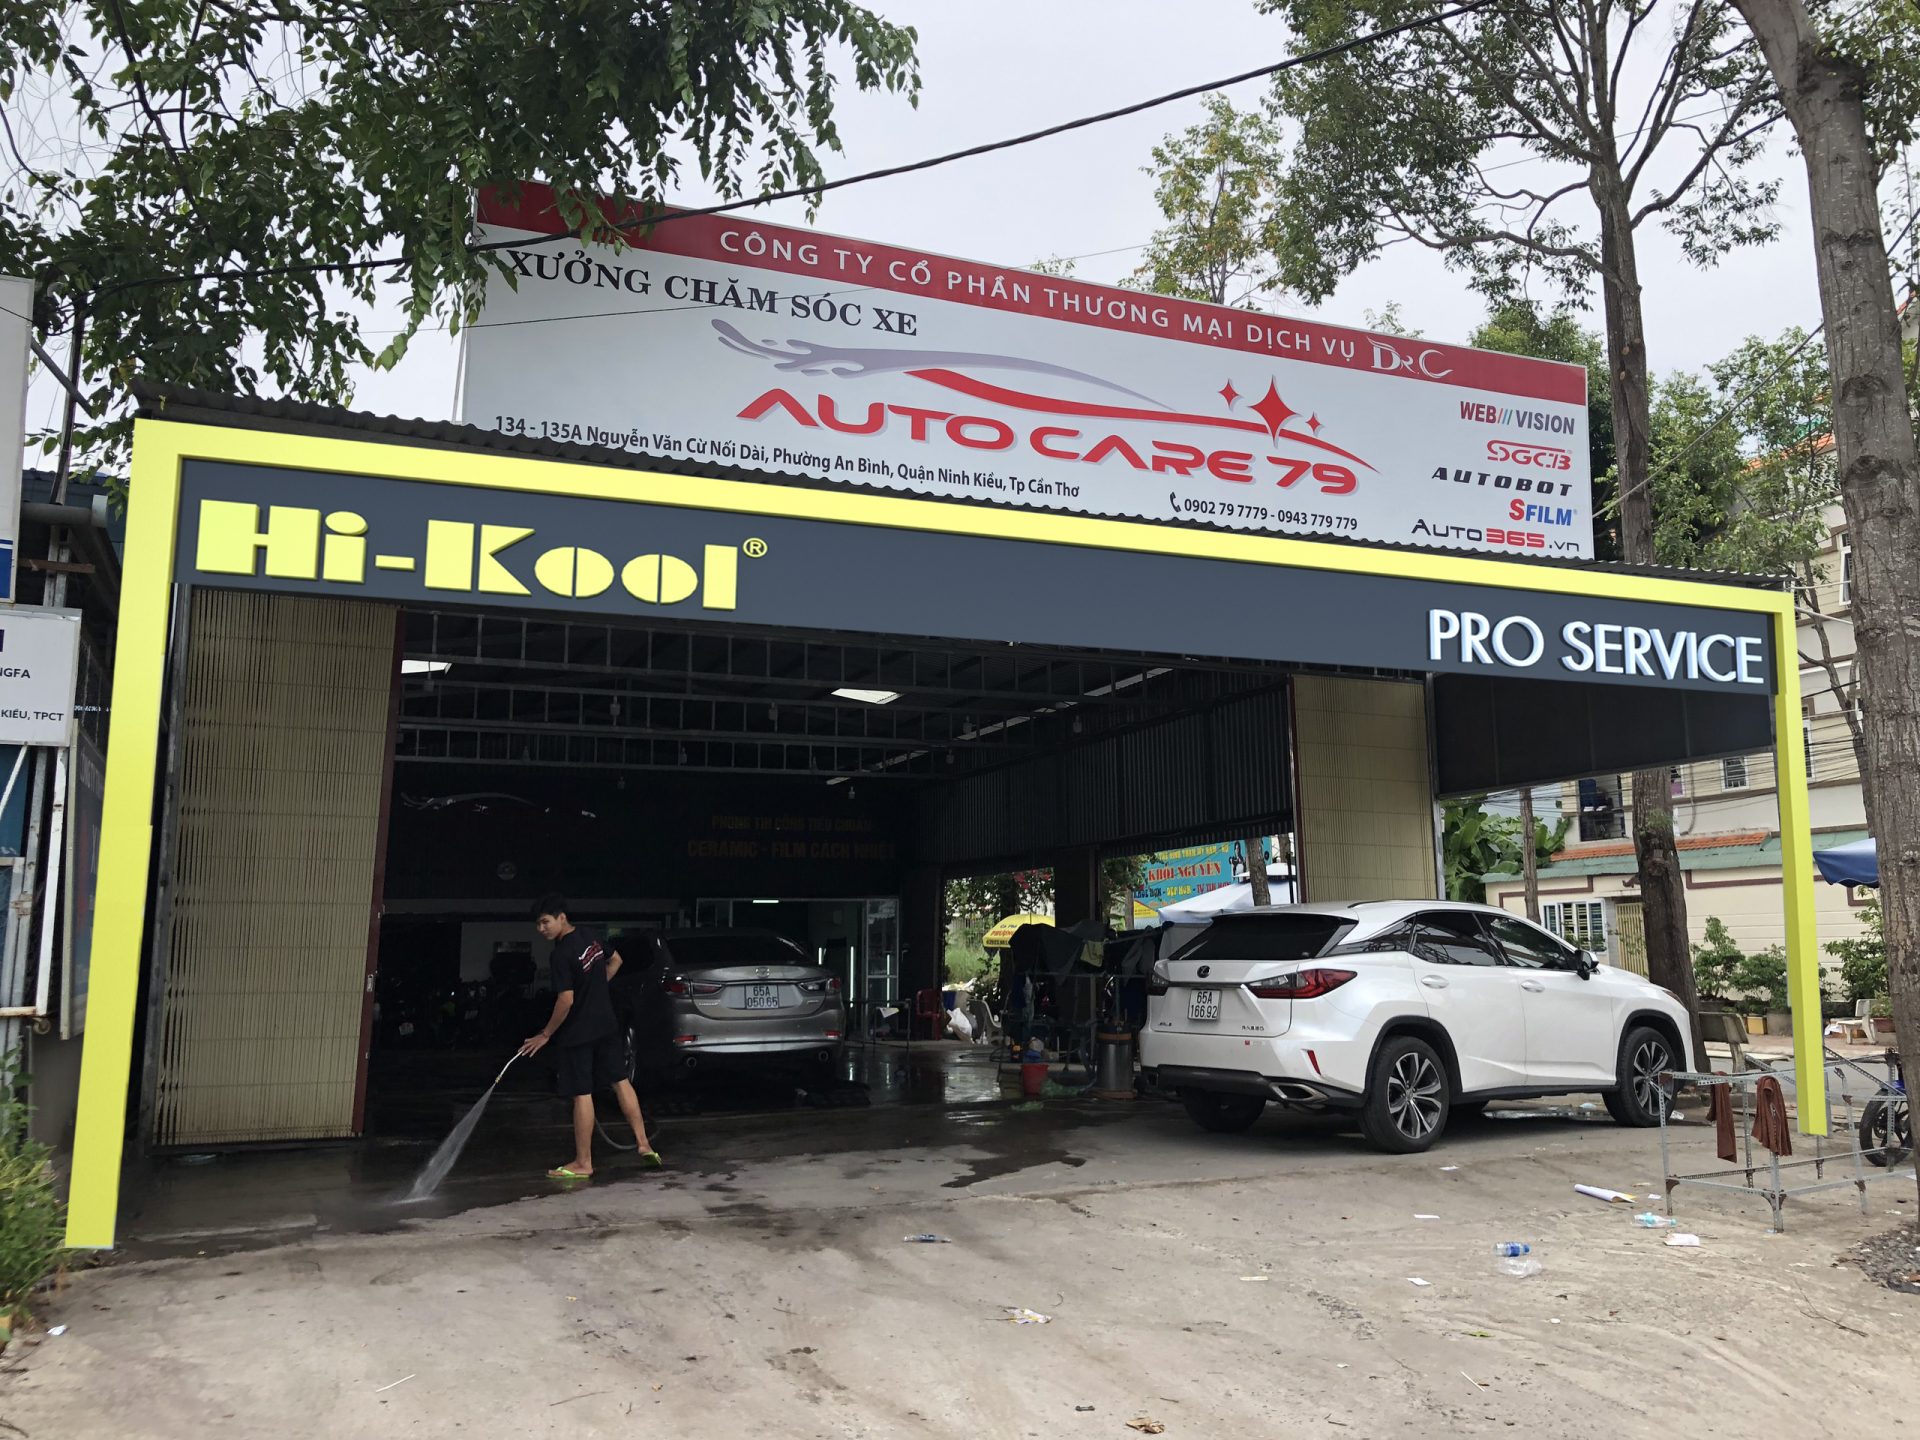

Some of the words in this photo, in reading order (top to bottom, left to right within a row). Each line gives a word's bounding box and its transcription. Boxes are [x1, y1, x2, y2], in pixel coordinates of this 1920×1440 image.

[506, 249, 652, 295] XƯỞNG
[664, 277, 779, 314] CHĂM
[791, 292, 862, 327] SÓC
[872, 308, 918, 337] XE
[719, 231, 819, 266] CÔNG
[833, 248, 874, 274] TY
[888, 259, 932, 286] CỔ
[947, 271, 1031, 304] PHẦN
[1043, 288, 1170, 328] THƯƠNG
[1182, 313, 1233, 344] MẠI
[1247, 323, 1310, 353] DỊCH
[1322, 337, 1356, 363] VỤ
[494, 415, 526, 434] 134
[540, 421, 583, 441] 135A
[586, 425, 650, 449] Nguyễn
[652, 433, 683, 453] Văn
[686, 437, 708, 455] Cừ
[710, 440, 737, 459] Nối
[740, 444, 771, 465] Dài,
[773, 447, 831, 473] Phường
[833, 456, 855, 472] An
[858, 455, 895, 479] Bình,
[897, 463, 935, 485] Quận
[938, 467, 971, 487] Ninh
[973, 471, 1007, 492] Kiều,
[1009, 476, 1026, 495] Tp
[1028, 477, 1053, 495] Cần
[1055, 482, 1080, 498] Thơ
[736, 388, 1015, 450] AUTO
[1030, 426, 1254, 483] CARE
[1266, 455, 1358, 495] 79
[1431, 467, 1573, 497] AUTOBOT
[1183, 498, 1216, 516] 0902
[1219, 502, 1235, 517] 79
[1237, 504, 1268, 521] 7779
[1277, 510, 1308, 526] 0943
[1310, 513, 1334, 528] 779
[1335, 516, 1358, 531] 779
[1428, 607, 1546, 669] PRO
[1560, 619, 1765, 685] SERVICE
[33, 711, 65, 722] TPCT
[753, 985, 771, 997] 65A
[1196, 991, 1213, 1004] 65A
